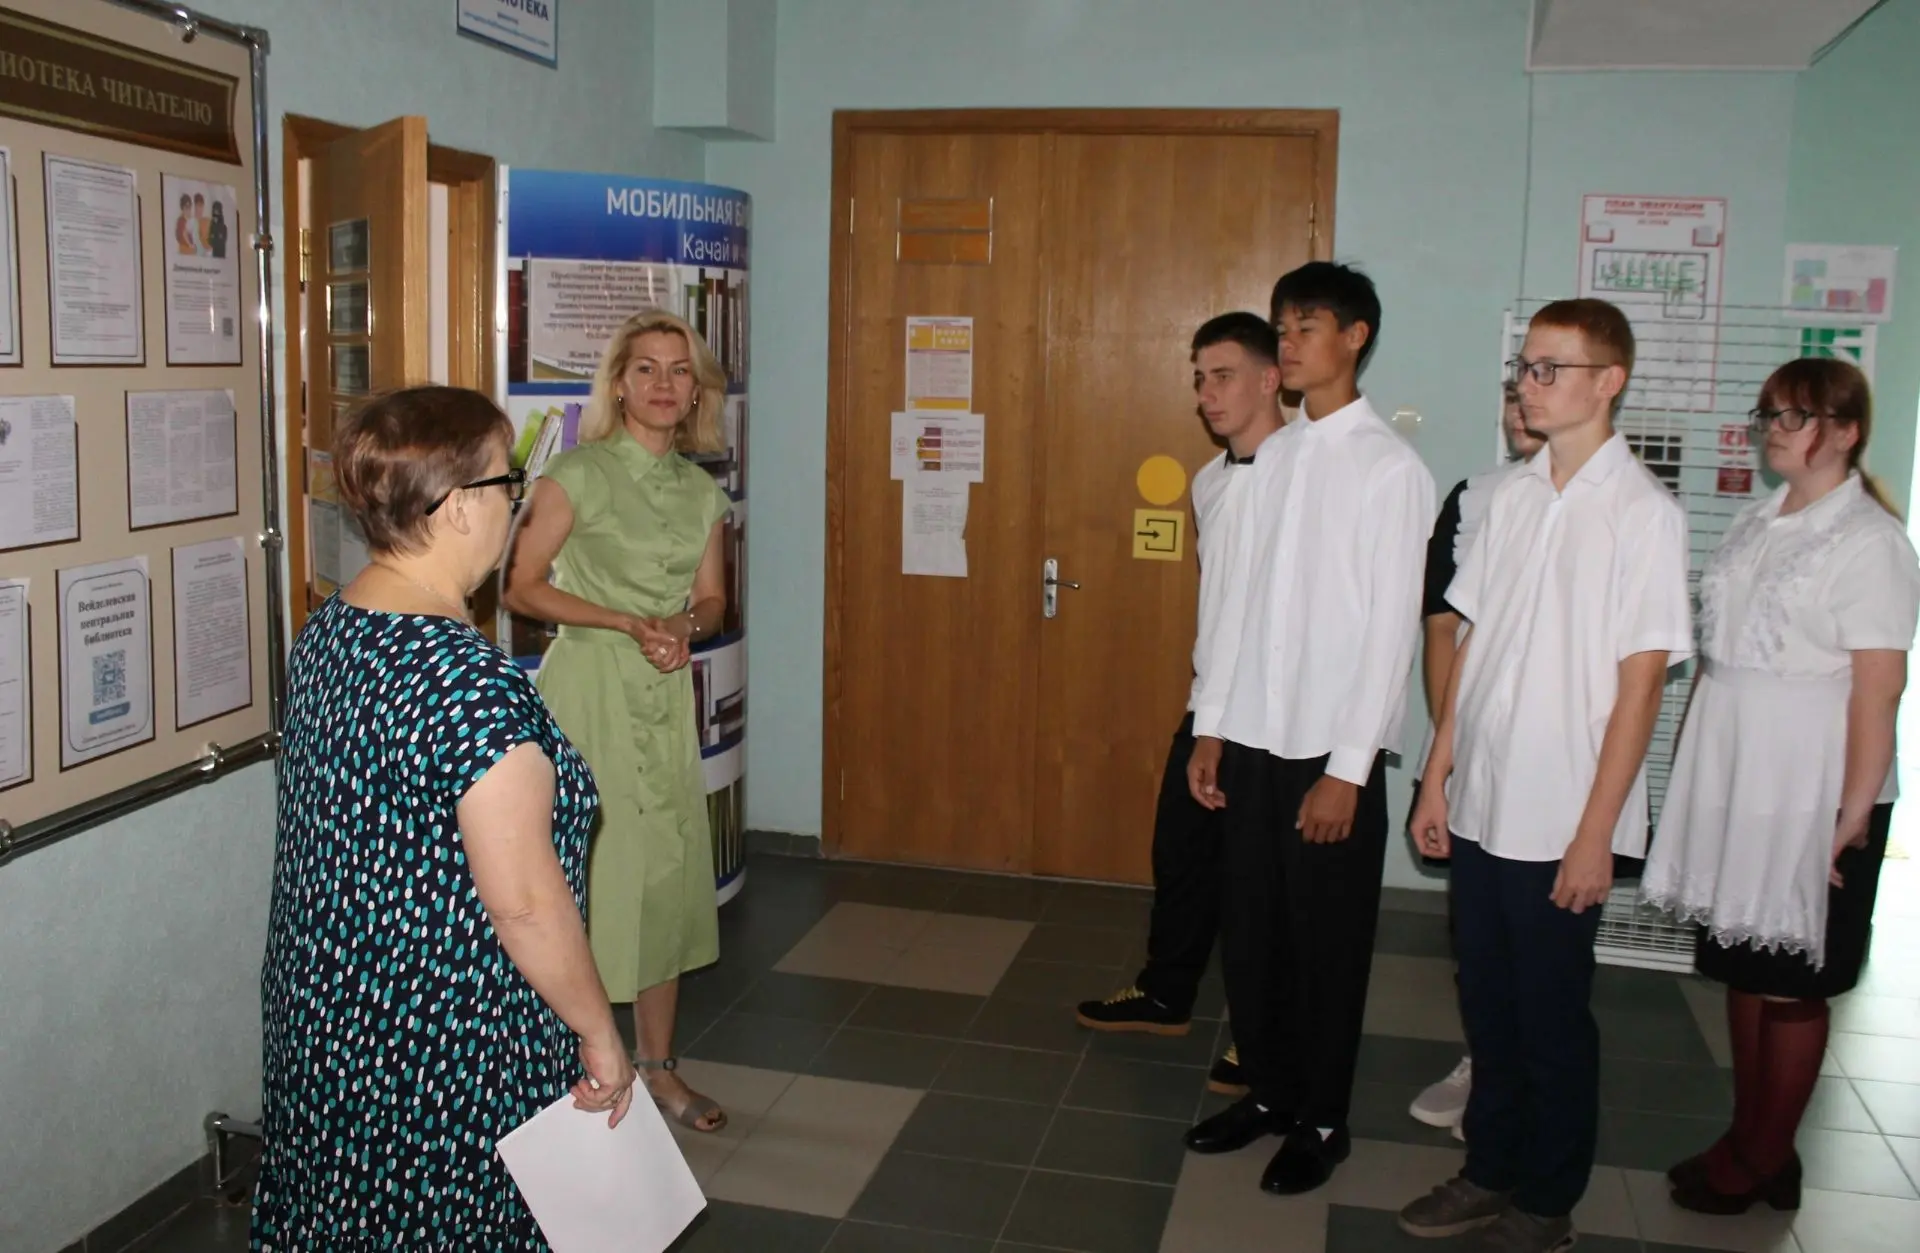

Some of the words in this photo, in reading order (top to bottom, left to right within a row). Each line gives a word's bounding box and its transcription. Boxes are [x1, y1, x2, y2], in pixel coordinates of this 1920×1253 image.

[101, 76, 213, 126] ЧИТАТЕЛЮ
[606, 187, 732, 226] МОБИЛЬНАЯ
[683, 231, 730, 262] Качай
[84, 626, 133, 646] библиотека
